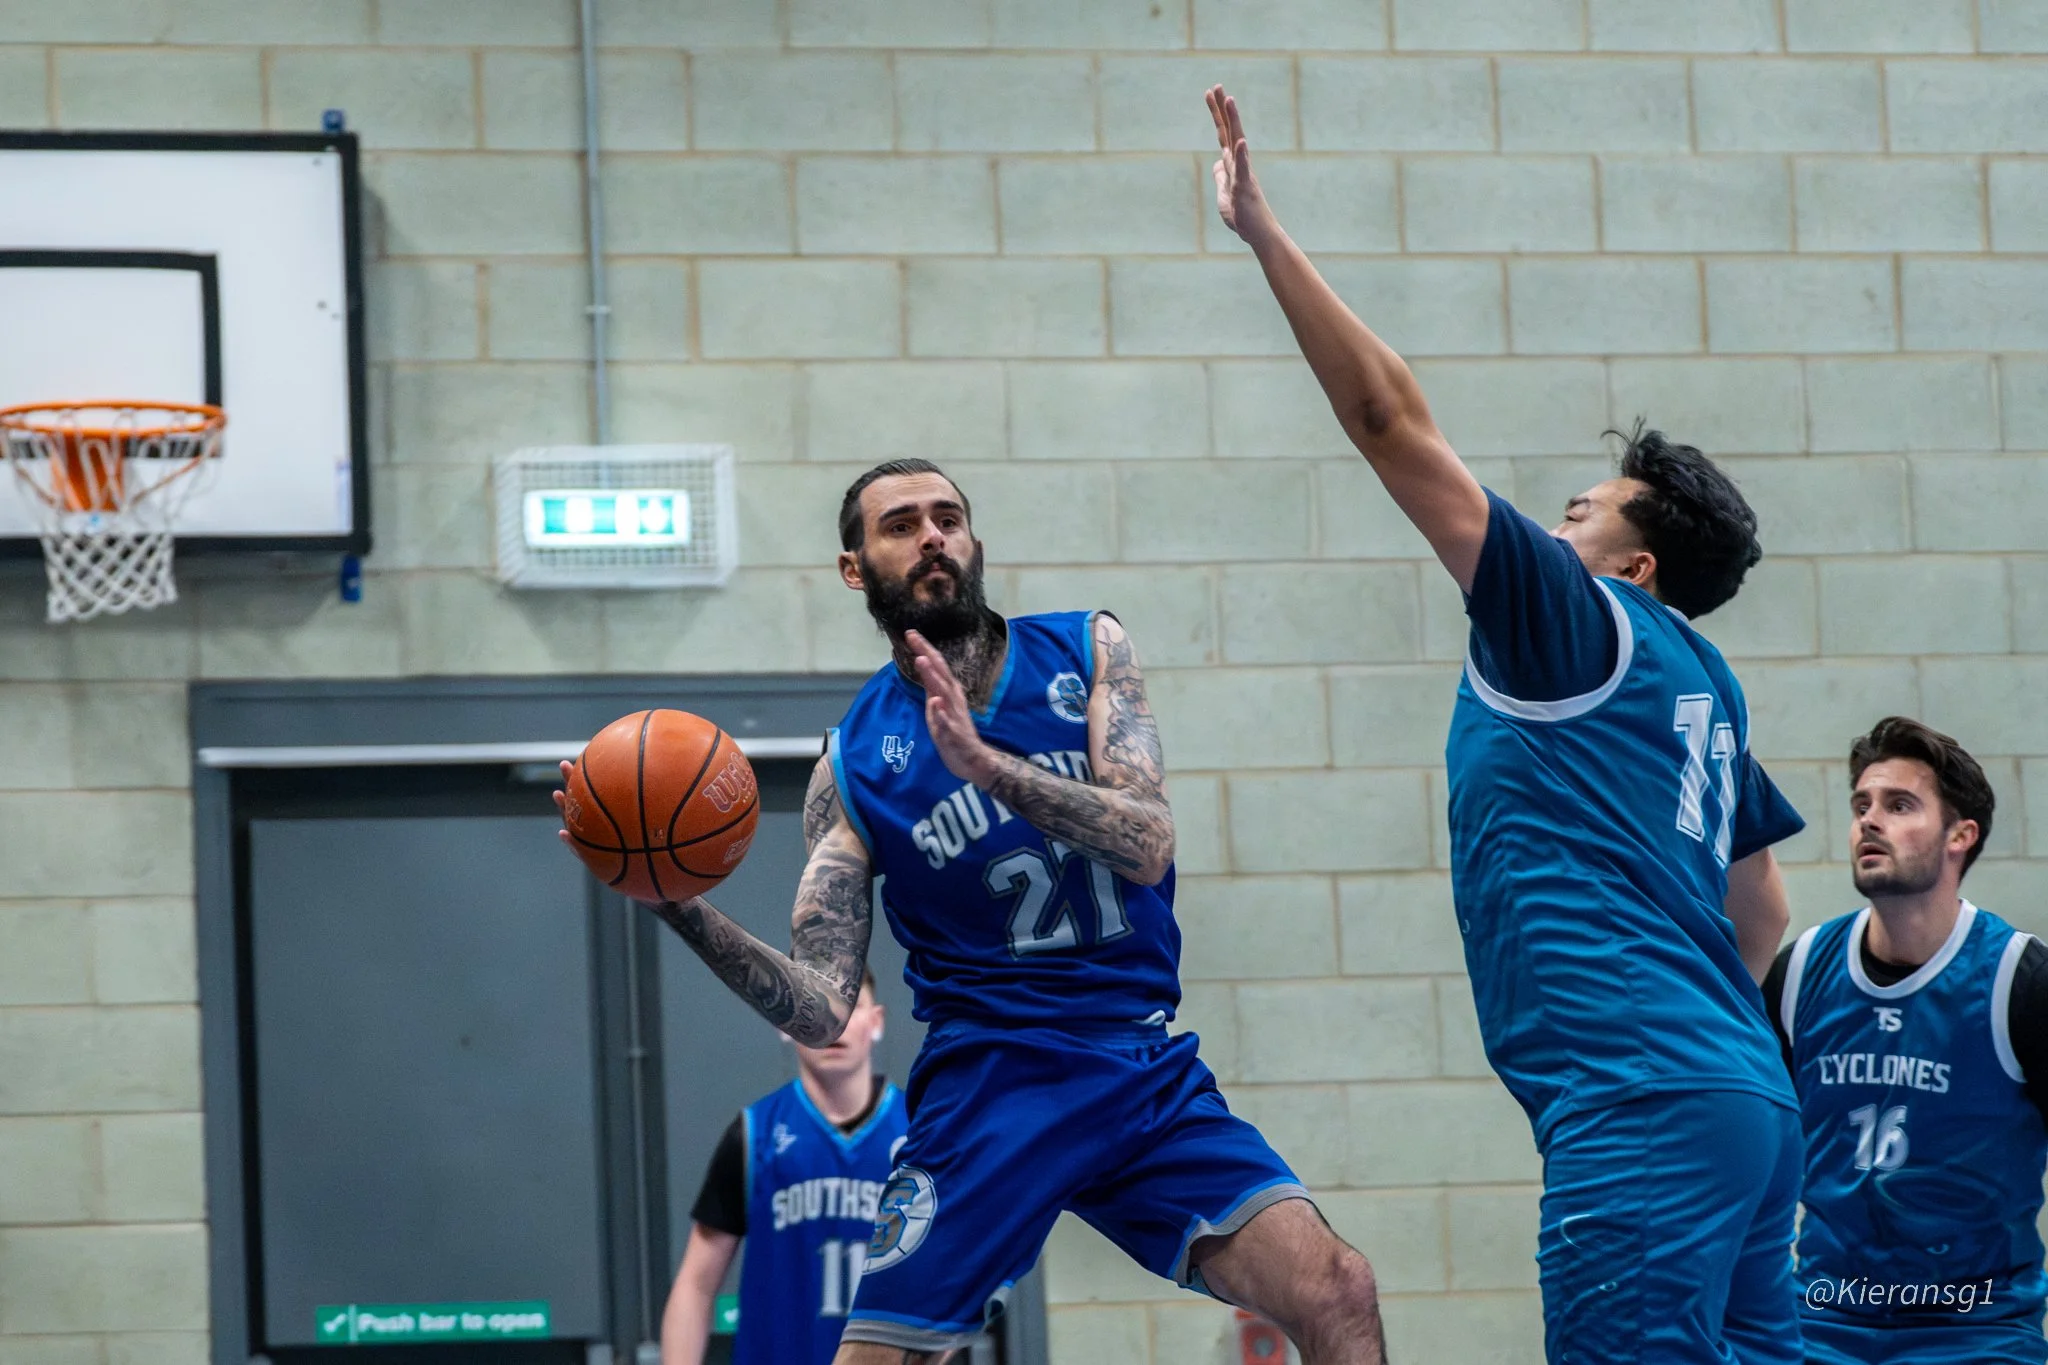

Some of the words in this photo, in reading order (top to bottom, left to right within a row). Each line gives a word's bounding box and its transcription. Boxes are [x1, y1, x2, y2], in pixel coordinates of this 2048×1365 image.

[1818, 1053, 1951, 1094] CYCLONES
[1848, 1103, 1910, 1172] 16
[771, 1176, 884, 1232] SOUTHS
[357, 1312, 416, 1333] Push
[418, 1311, 457, 1332] bar
[461, 1311, 486, 1331] to
[488, 1312, 547, 1334] open
